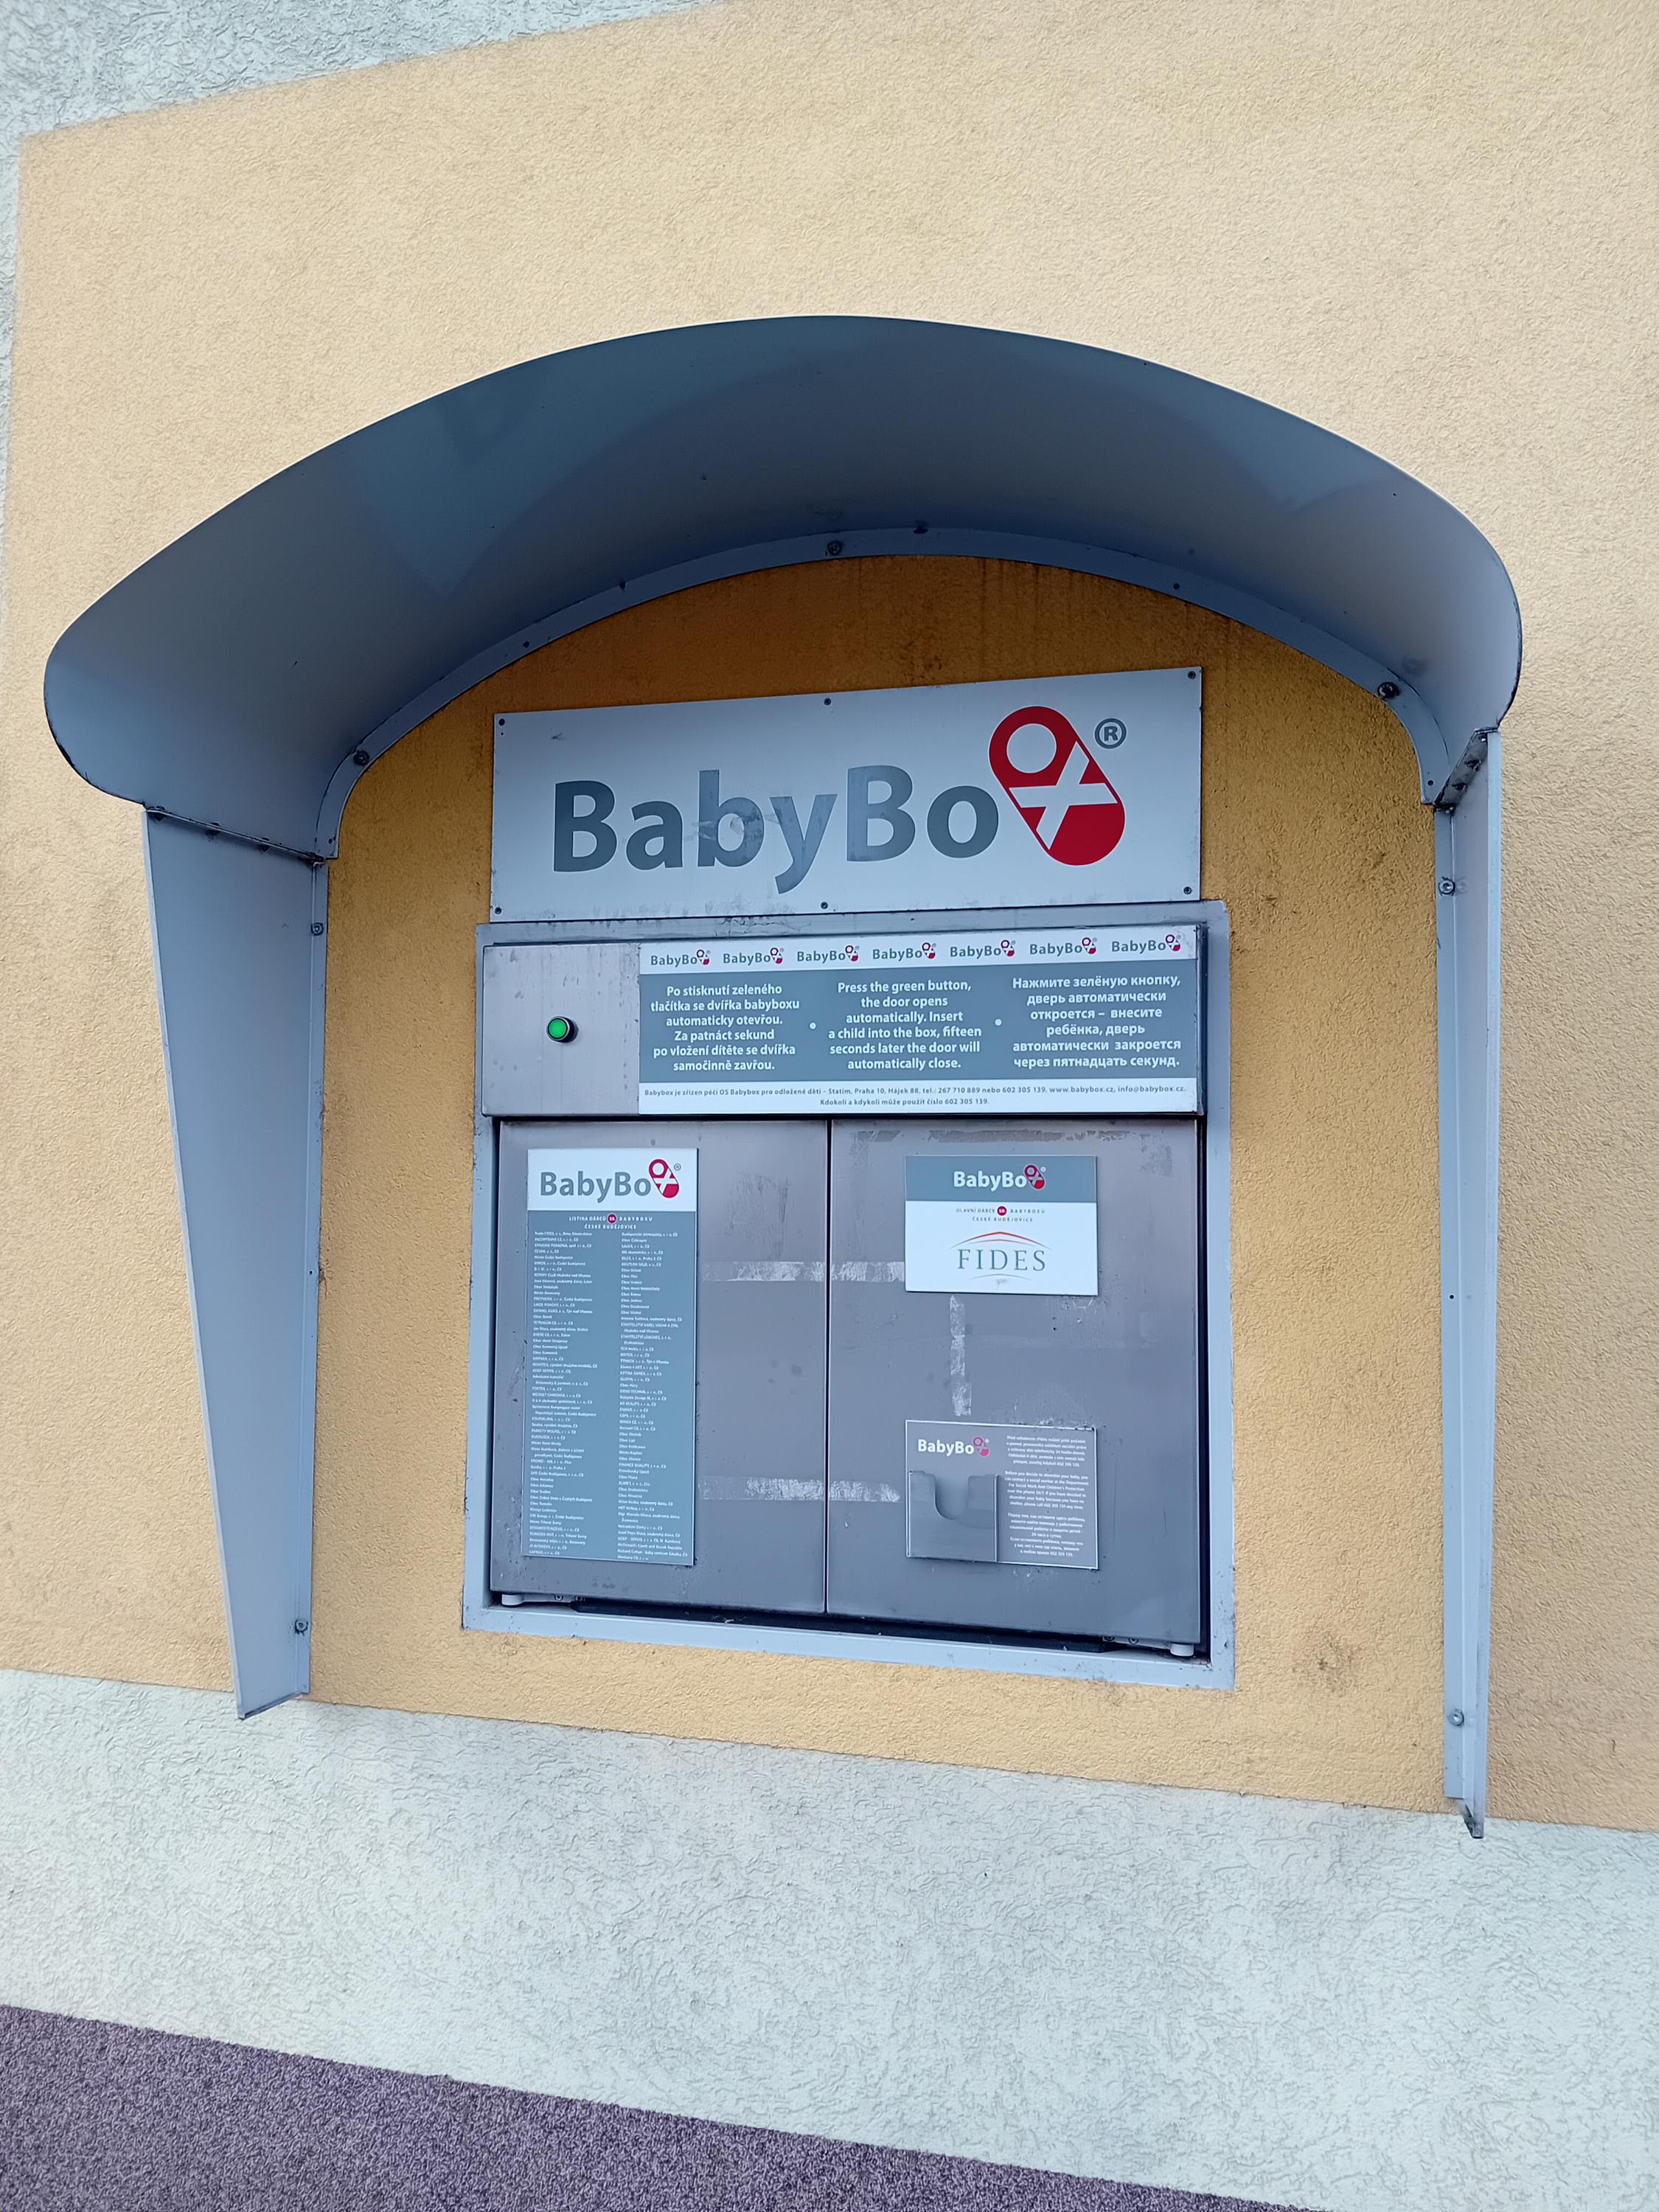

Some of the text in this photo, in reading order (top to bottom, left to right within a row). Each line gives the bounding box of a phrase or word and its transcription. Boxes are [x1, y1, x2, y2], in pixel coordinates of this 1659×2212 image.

[667, 983, 782, 995] Po stisknutí zeleného
[838, 979, 970, 993] Press the green button,
[1013, 975, 1180, 989] Нажмите зелёную кнопку,
[651, 1000, 689, 1011] tlačítka
[707, 999, 741, 1009] dvířka
[745, 998, 799, 1012] babyboxu
[861, 996, 947, 1009] the door opens
[1027, 992, 1166, 1006] дверь автоматически
[667, 1014, 782, 1029] automaticky otevřou.
[846, 1011, 962, 1025] automatically. Insert
[1030, 1010, 1094, 1021] откроется
[1110, 1009, 1161, 1018] внесите
[675, 1029, 773, 1043] Za patnáct sekund
[838, 1027, 864, 1038] child
[868, 1027, 890, 1037] into
[893, 1026, 912, 1037] the
[915, 1026, 939, 1038] box,
[943, 1025, 981, 1036] fifteen
[1046, 1023, 1144, 1037] ребёнка, дверь
[654, 1048, 667, 1058] po
[670, 1045, 709, 1055] vložení
[712, 1044, 743, 1054] dítěte
[760, 1043, 795, 1054] dvířka
[830, 1041, 979, 1054] seconds later the door will
[1013, 1040, 1180, 1051] автоматически закроется
[673, 1060, 774, 1071] samočinně zavřou.
[848, 1057, 961, 1071] automatically close.
[1014, 1057, 1179, 1069] через пятнадцать секунд.
[674, 1089, 681, 1097] je
[958, 1249, 1045, 1270] FIDES
